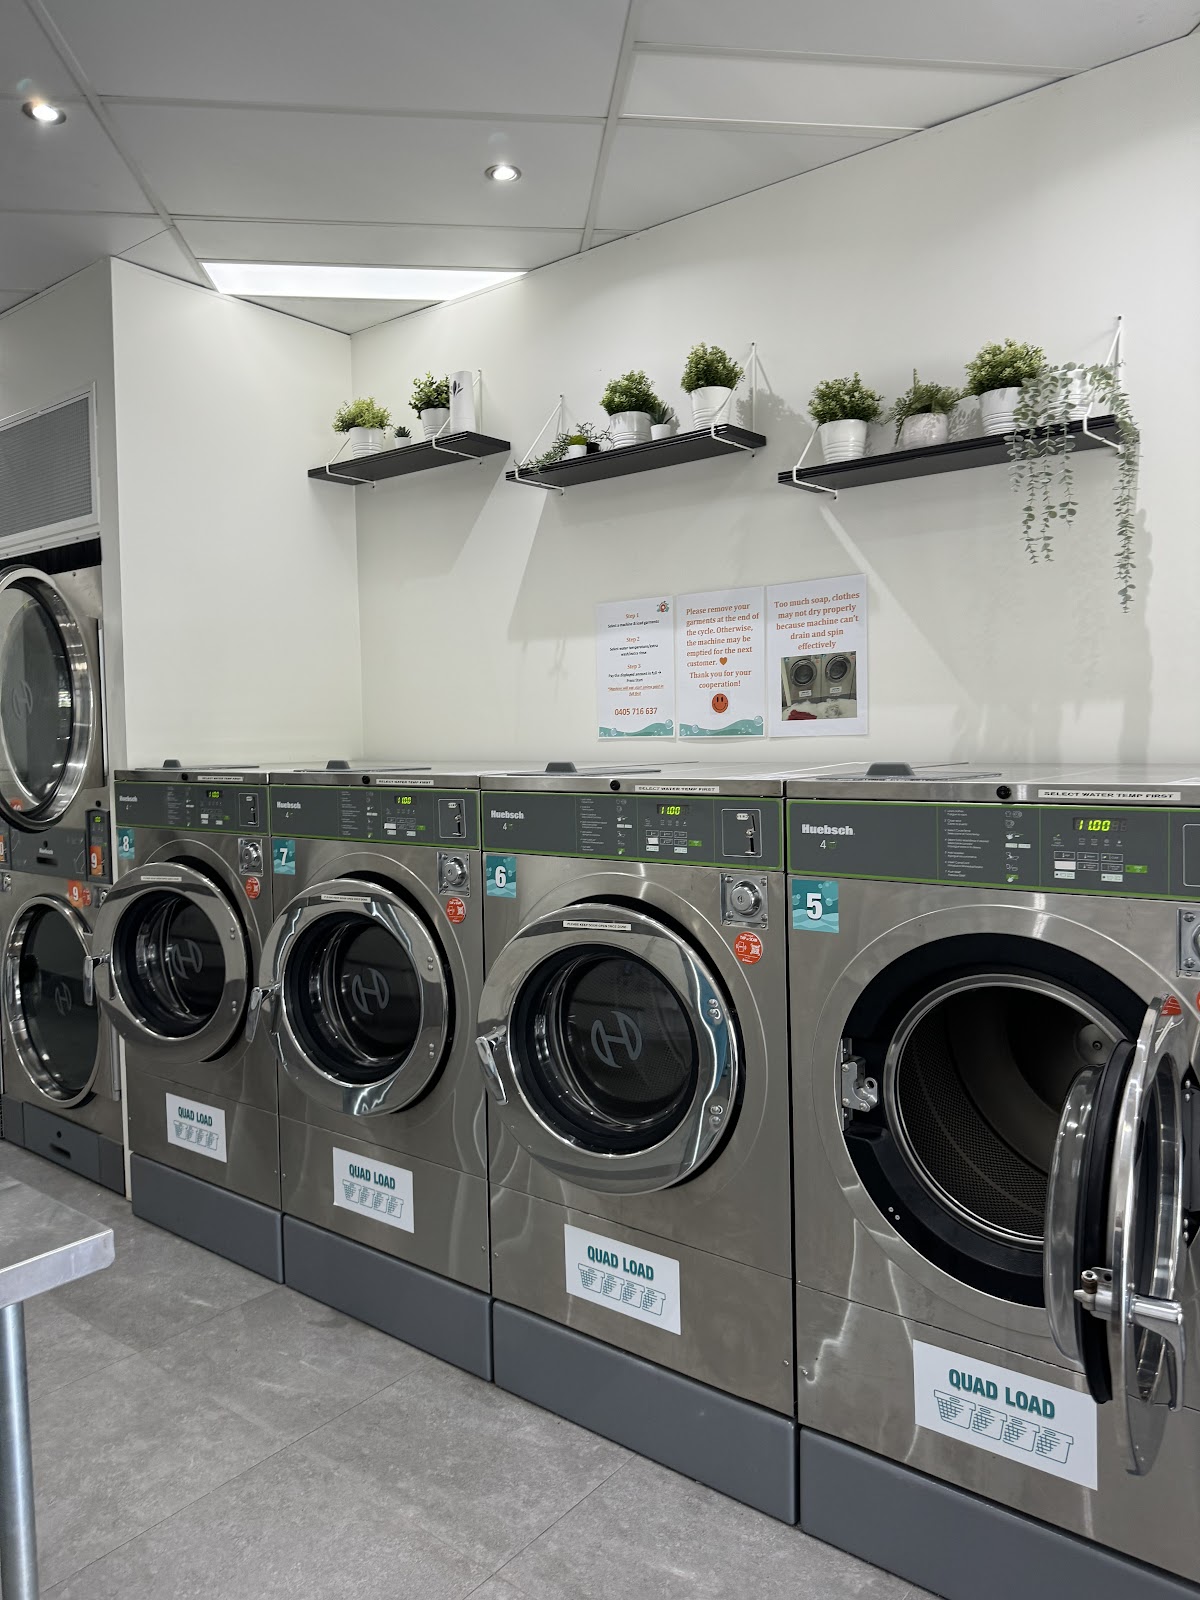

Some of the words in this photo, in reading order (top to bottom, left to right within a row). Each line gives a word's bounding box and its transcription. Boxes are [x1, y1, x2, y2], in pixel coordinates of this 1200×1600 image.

[789, 598, 810, 607] much
[811, 596, 831, 605] soap,
[831, 592, 860, 602] clothes
[707, 605, 733, 613] remove
[733, 603, 751, 612] your
[808, 608, 822, 616] dry
[822, 603, 857, 615] properly
[686, 617, 716, 627] garments
[725, 614, 737, 622] the
[737, 613, 751, 621] end
[751, 612, 760, 620] of
[806, 617, 839, 627] machine
[716, 624, 753, 634] Otherwise,
[790, 632, 810, 640] drain
[811, 630, 826, 638] and
[827, 628, 844, 637] spin
[697, 637, 725, 646] machine
[726, 637, 741, 645] may
[798, 640, 837, 650] effectively
[686, 649, 713, 657] emptied
[689, 671, 710, 679] Thank
[735, 670, 752, 678] your
[698, 680, 741, 689] cooperation!
[614, 708, 631, 716] 0405
[632, 707, 644, 715] 716
[645, 707, 658, 715] 637
[490, 809, 525, 819] Huebsch
[801, 823, 854, 836] Huebsch
[122, 835, 130, 852] 8
[819, 839, 827, 849] 4
[90, 853, 98, 869] 9
[279, 848, 288, 866] 7
[494, 866, 507, 889] 6
[71, 886, 79, 901] 9
[805, 892, 823, 921] 5
[178, 1105, 195, 1121] QUAD
[197, 1111, 213, 1128] LOAD
[348, 1163, 371, 1182] QUAD
[373, 1171, 396, 1190] LOAD
[587, 1245, 619, 1269] QUAD
[622, 1257, 654, 1281] LOAD
[948, 1368, 998, 1401] QUAD
[1005, 1386, 1055, 1419] LOAD
